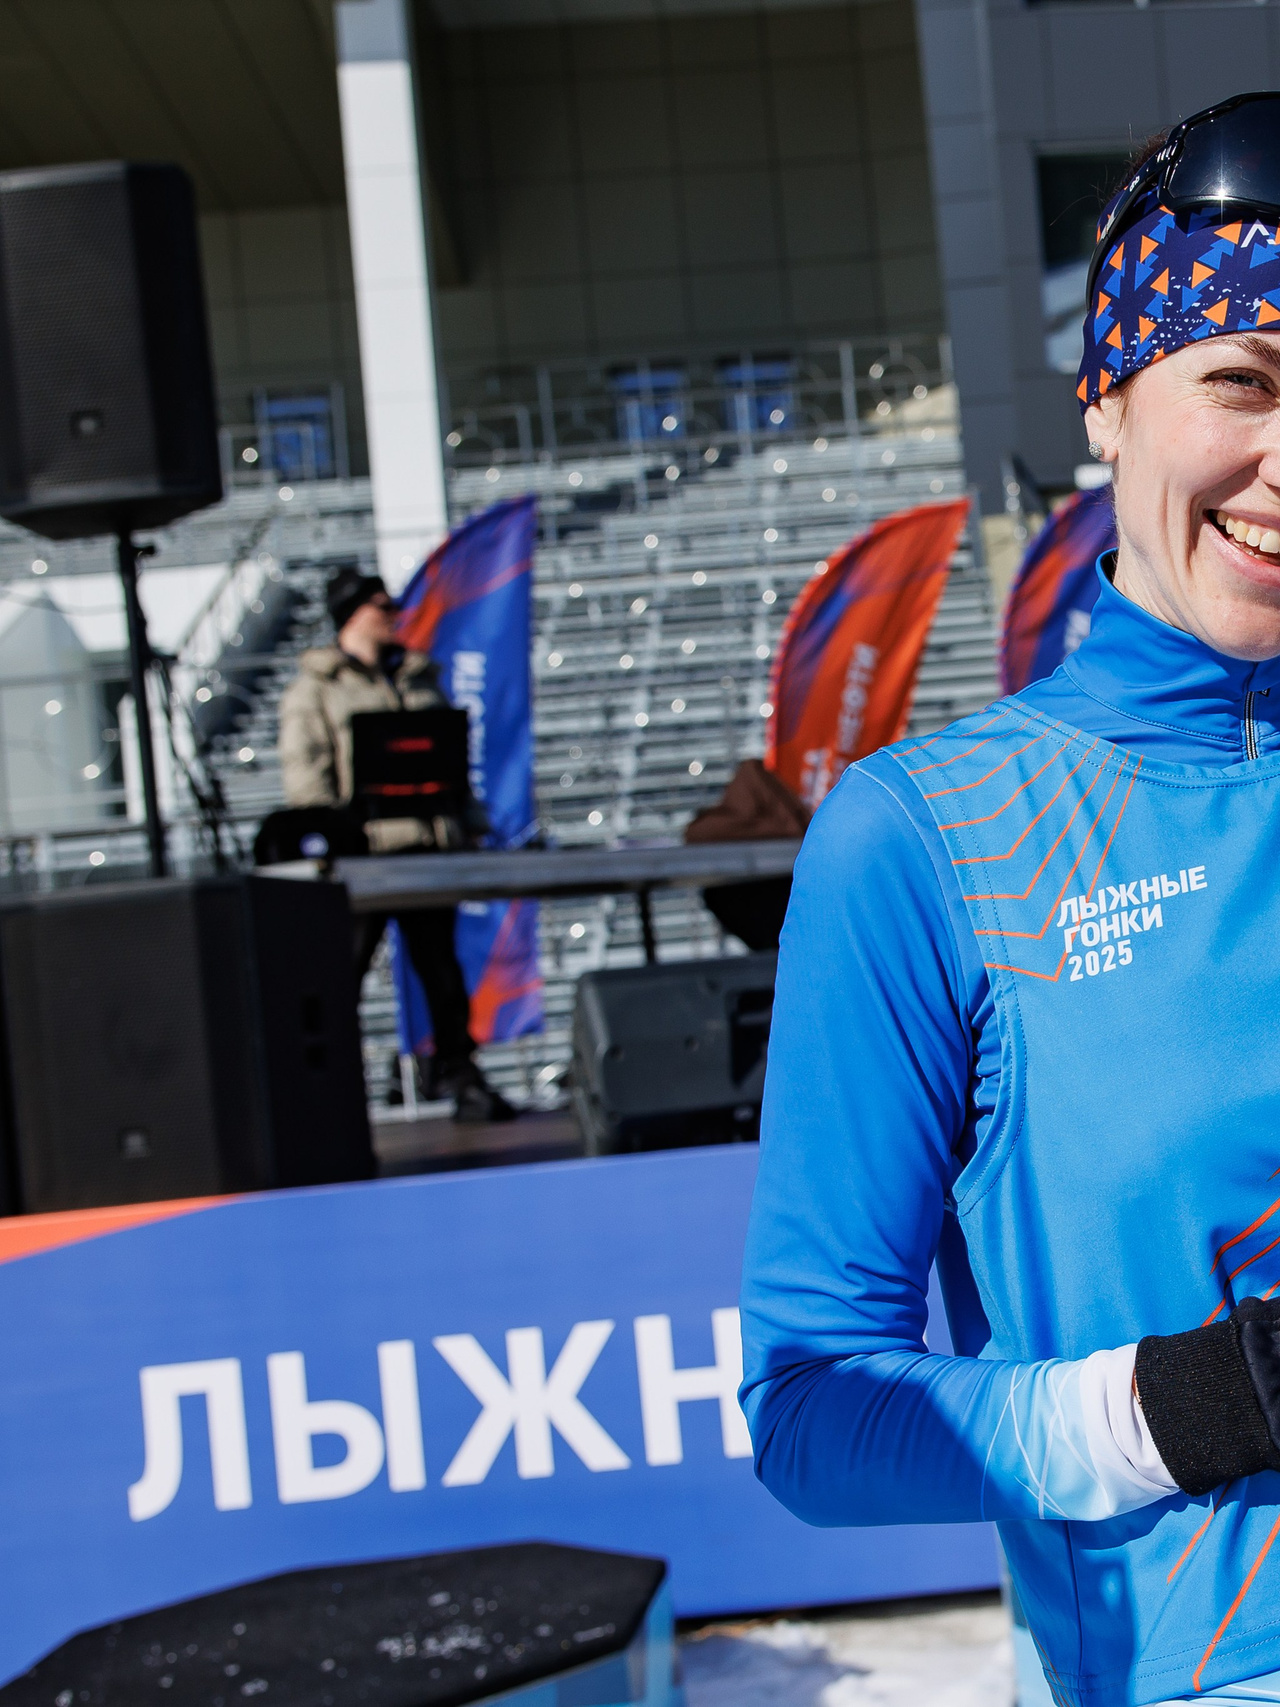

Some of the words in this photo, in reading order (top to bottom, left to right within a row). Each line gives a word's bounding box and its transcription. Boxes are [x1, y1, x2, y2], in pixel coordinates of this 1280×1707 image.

[1056, 865, 1208, 928] ЛЫЖНЫЕ
[1063, 903, 1164, 954] ГОНКИ
[1068, 939, 1133, 982] 2025
[127, 1306, 754, 1523] ЛЫЖН
